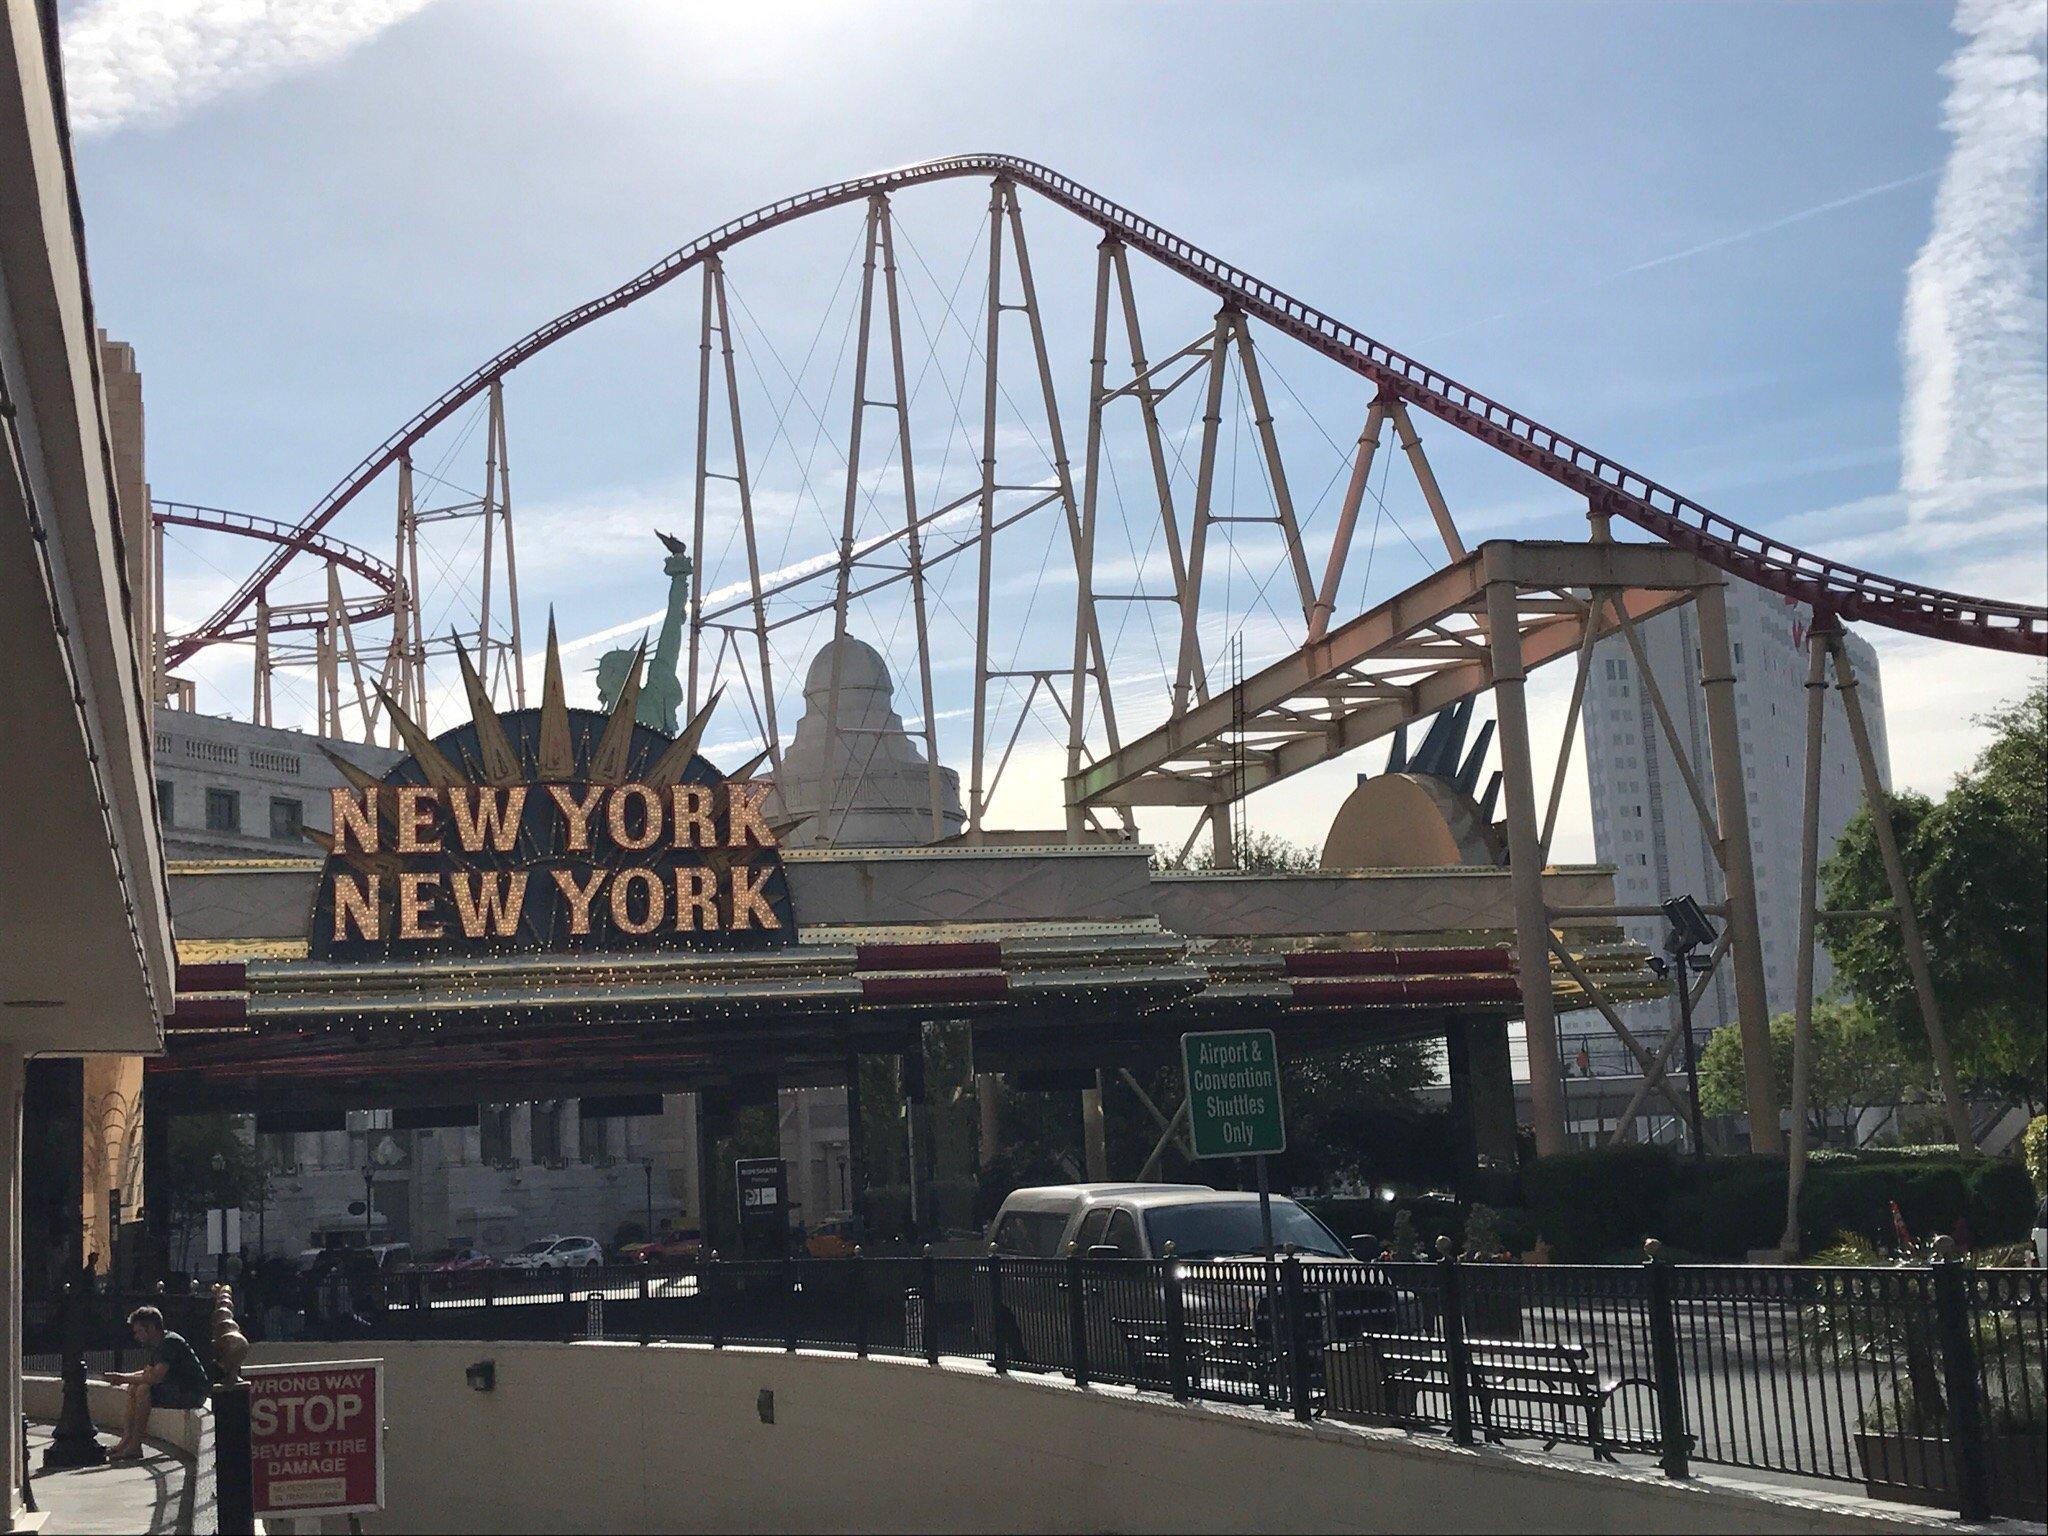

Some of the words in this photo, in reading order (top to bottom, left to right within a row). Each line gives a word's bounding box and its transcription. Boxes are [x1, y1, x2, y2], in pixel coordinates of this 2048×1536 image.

[330, 784, 527, 854] NEW
[548, 781, 779, 850] YORK
[332, 870, 529, 941] NEW
[550, 866, 782, 935] YORK
[1200, 1041, 1248, 1068] Airport
[1251, 1040, 1262, 1062] &
[1194, 1067, 1272, 1091] Convention
[1206, 1094, 1264, 1118] Shuttles
[1222, 1121, 1253, 1146] Only
[250, 1375, 320, 1394] WRONG
[325, 1374, 365, 1390] WAY
[251, 1394, 362, 1436] STOP
[251, 1441, 321, 1460] SEVERE
[325, 1438, 367, 1455] TIRE
[268, 1458, 347, 1476] DAMAGE
